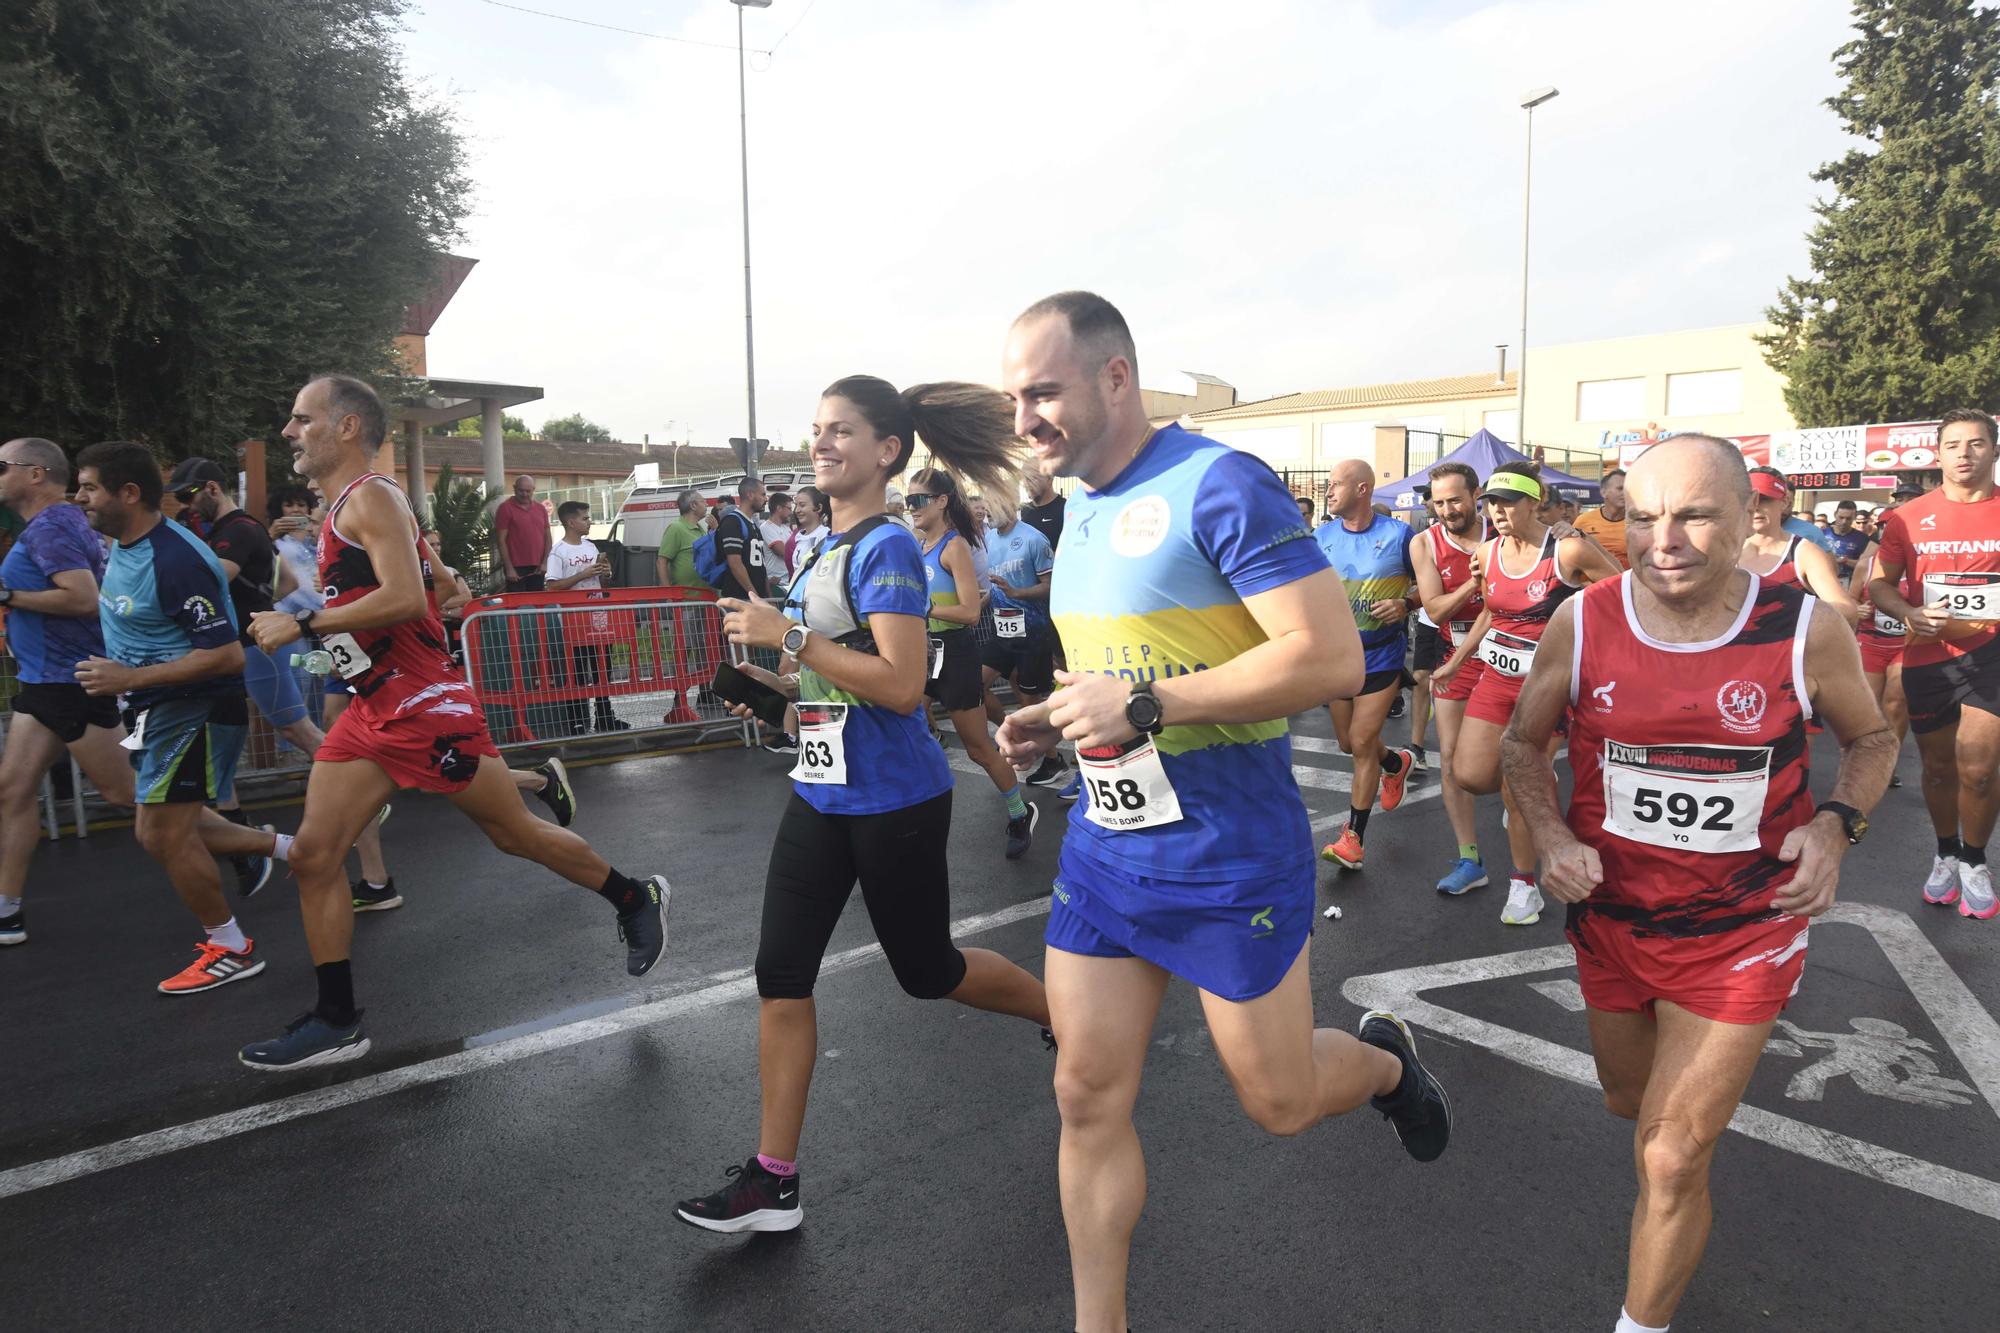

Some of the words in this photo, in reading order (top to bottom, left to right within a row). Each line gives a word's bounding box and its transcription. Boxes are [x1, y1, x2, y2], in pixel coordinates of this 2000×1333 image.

[1800, 429, 1858, 441] XXVIII
[1800, 439, 1858, 451] NON
[1800, 449, 1858, 462] DUER
[1800, 460, 1858, 471] MAS
[750, 538, 765, 567] 6
[998, 621, 1018, 633] 215
[1488, 650, 1520, 673] 300
[1609, 742, 1648, 765] XXVIII
[1648, 754, 1738, 772] NONDUERMAS
[804, 771, 825, 779] DESIREE
[1632, 787, 1735, 832] 592
[1118, 814, 1146, 826] BOND
[1672, 833, 1690, 844] YO
[647, 882, 659, 905] HOKA
